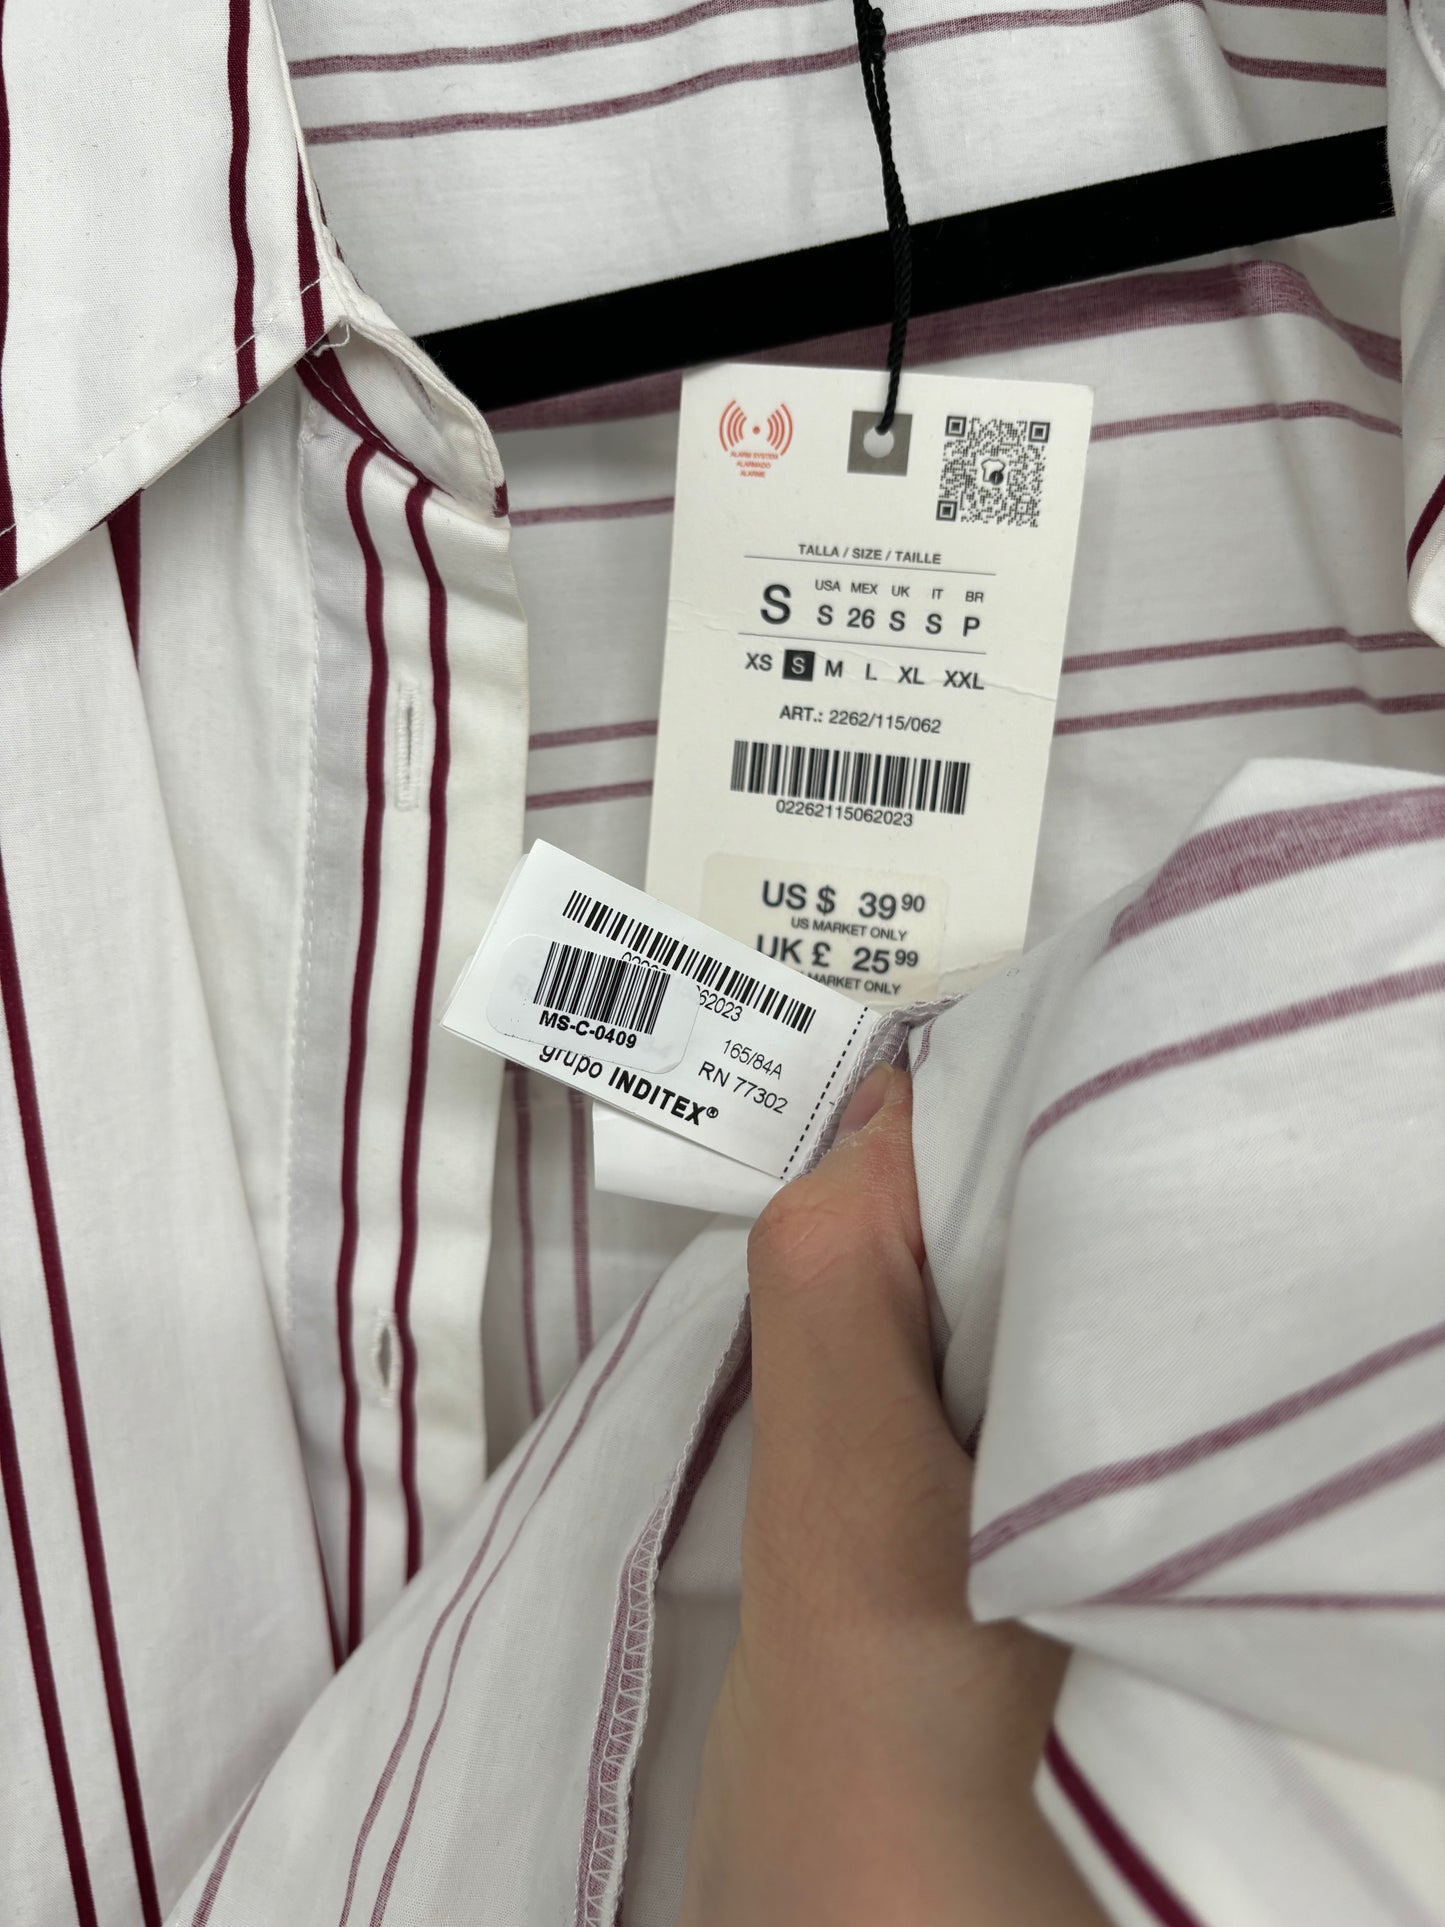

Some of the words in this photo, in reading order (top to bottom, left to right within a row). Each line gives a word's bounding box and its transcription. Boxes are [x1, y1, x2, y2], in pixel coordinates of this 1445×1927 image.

[799, 544, 839, 558] TALLA
[843, 547, 849, 558] /
[852, 548, 883, 561] SIZE
[885, 549, 891, 561] /
[896, 550, 942, 565] TAILLE
[814, 579, 841, 592] USA
[850, 582, 879, 595] MEX
[891, 585, 910, 598] UK
[931, 588, 944, 600] IT
[965, 591, 984, 603] BR
[760, 584, 792, 625] S
[817, 604, 833, 626] S
[847, 607, 876, 629] 26
[889, 610, 906, 632] S
[925, 613, 943, 635] S
[963, 616, 981, 637] P
[745, 653, 773, 672] XS
[791, 657, 806, 674] S
[824, 660, 844, 678] M
[865, 663, 878, 681] L
[897, 666, 925, 685] XL
[943, 669, 985, 690] XXL
[779, 705, 823, 723] ART.:
[828, 709, 942, 734] 2262/115/062
[776, 799, 913, 828] 02262115062023
[761, 880, 808, 910] US
[816, 884, 836, 916] $
[790, 917, 809, 929] US
[812, 919, 867, 938] MARKET
[870, 926, 907, 942] ONLY
[757, 934, 803, 965] UK
[811, 942, 831, 968] £
[864, 980, 901, 996] ONLY
[539, 1010, 637, 1049] MS-C-0409
[539, 1045, 603, 1078] grupo
[723, 1039, 782, 1080] 165/84A
[698, 1060, 731, 1088] RN
[733, 1076, 788, 1114] 77302
